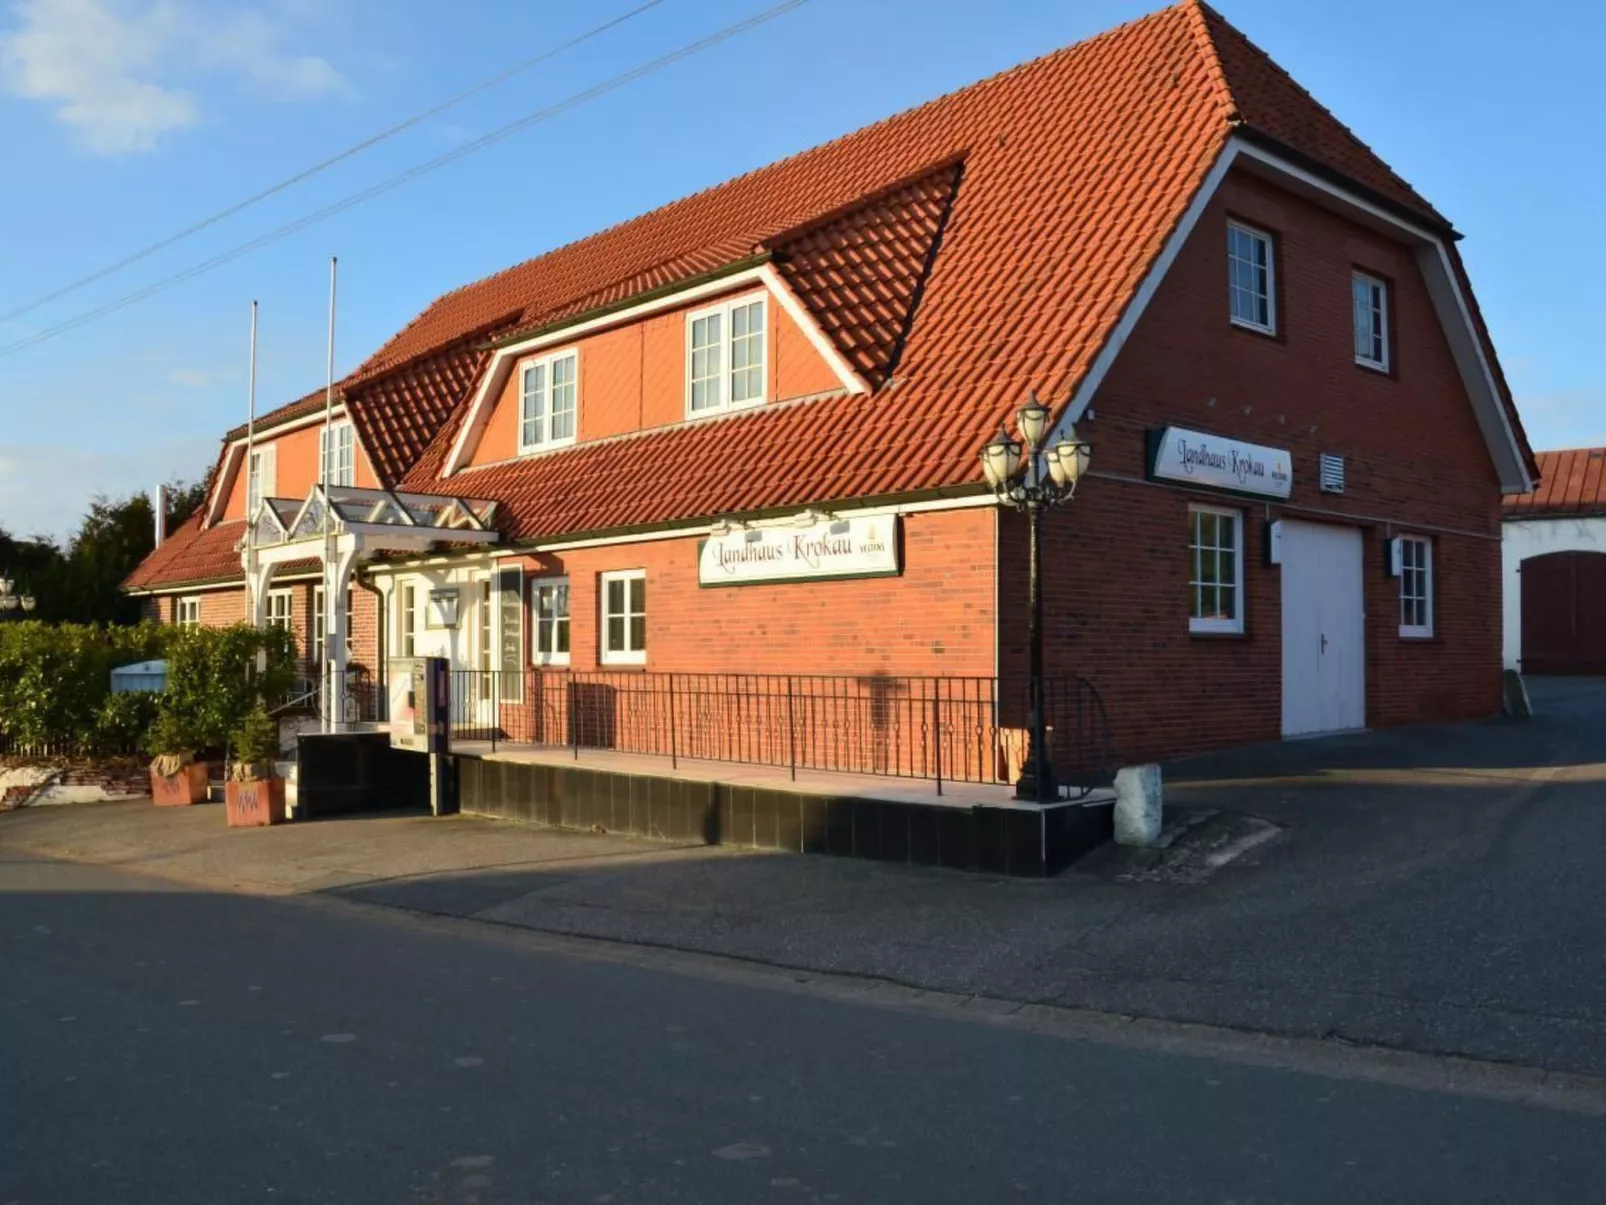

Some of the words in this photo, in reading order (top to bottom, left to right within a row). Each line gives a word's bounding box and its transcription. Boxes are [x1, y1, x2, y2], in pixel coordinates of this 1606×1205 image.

[1177, 438, 1227, 475] Landhaus
[1228, 449, 1265, 484] Krokau
[712, 539, 784, 575] Landhaus
[787, 532, 853, 569] Krokau
